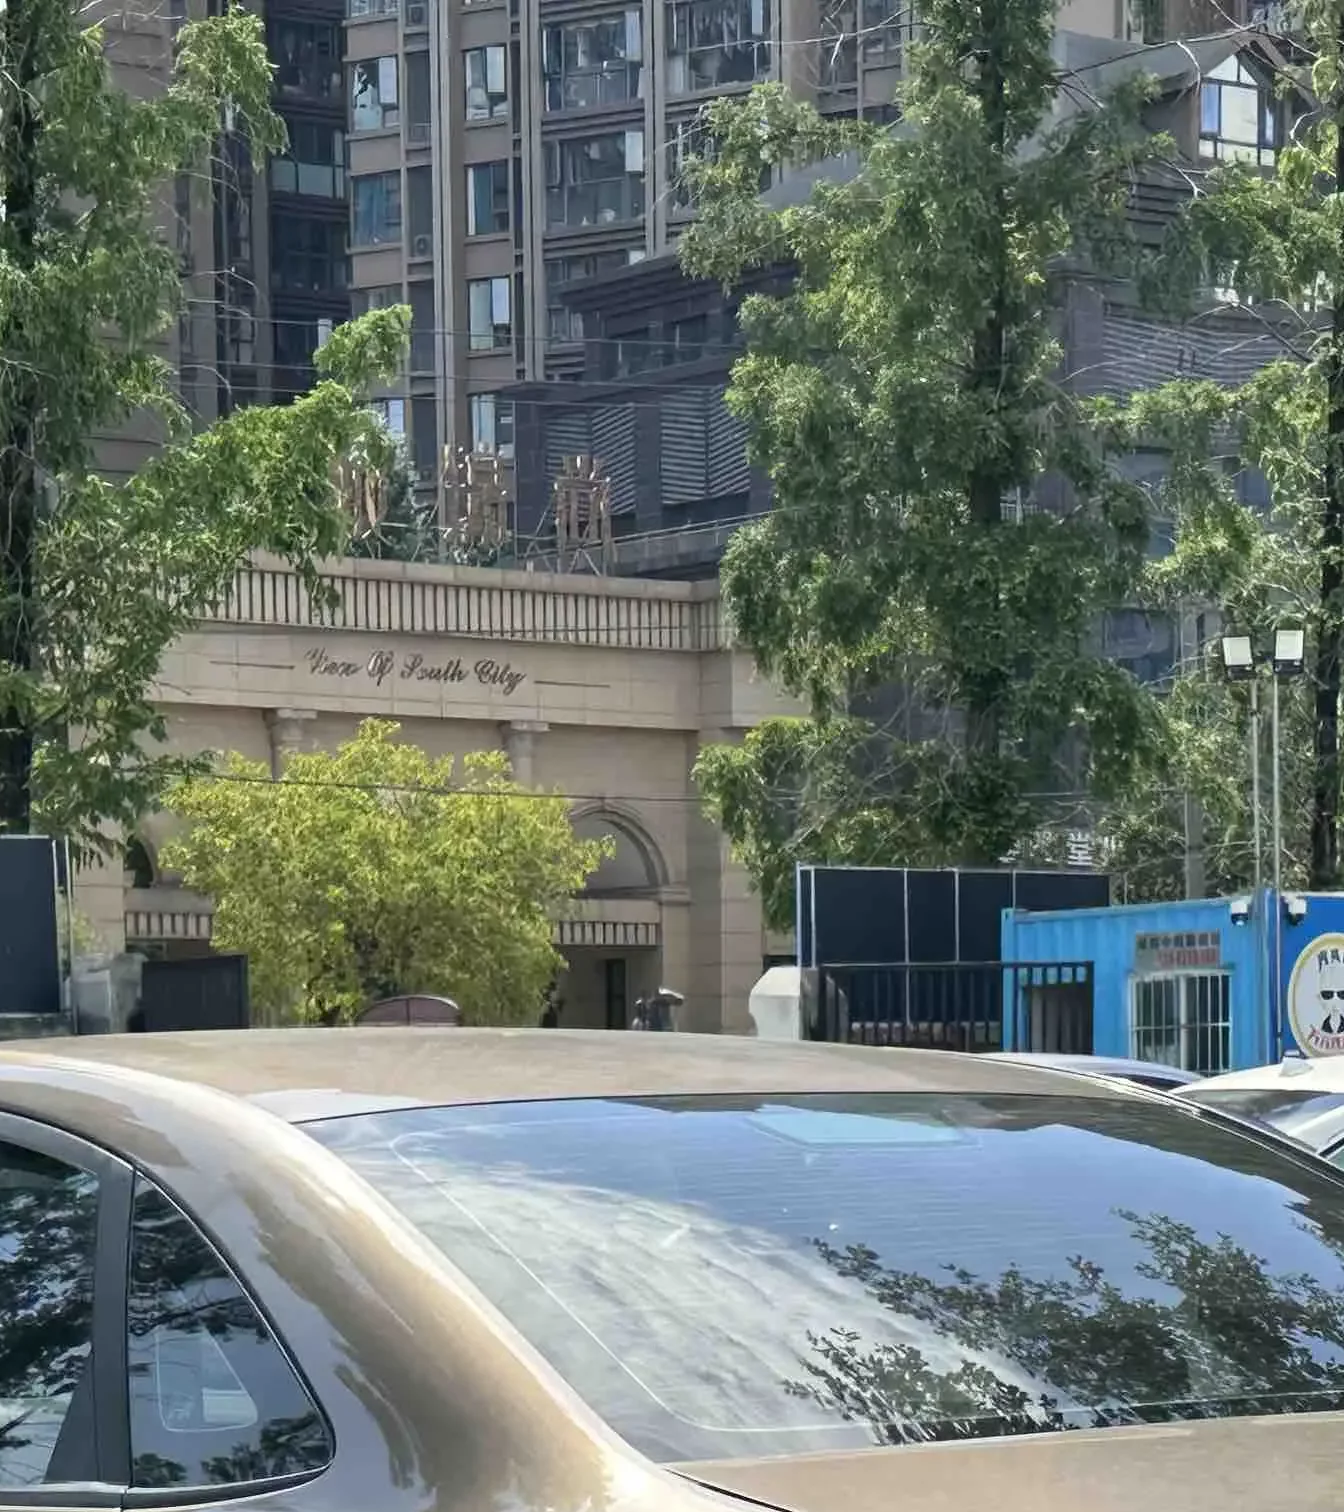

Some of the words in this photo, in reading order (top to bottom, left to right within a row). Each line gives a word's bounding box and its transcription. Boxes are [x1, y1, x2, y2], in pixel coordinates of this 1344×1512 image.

[367, 649, 395, 687] Of
[400, 652, 470, 682] South
[474, 658, 528, 696] City
